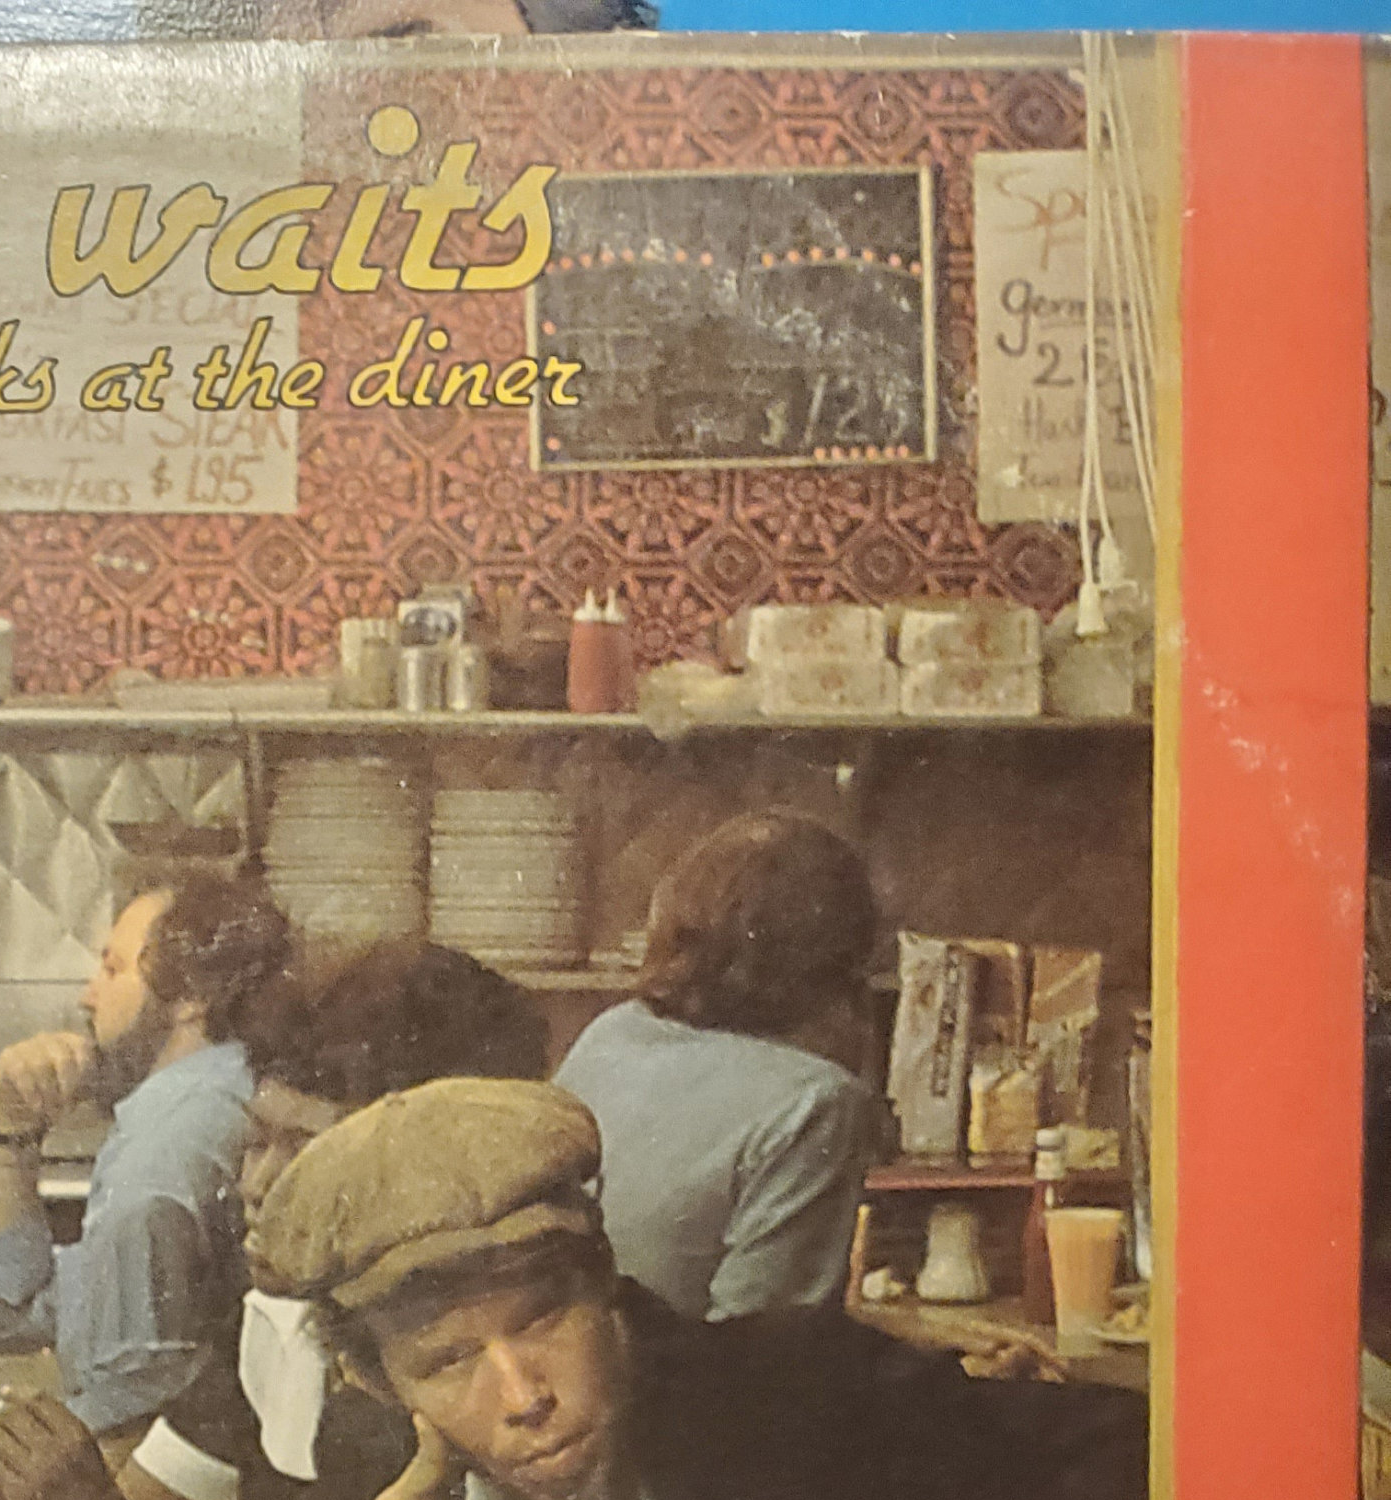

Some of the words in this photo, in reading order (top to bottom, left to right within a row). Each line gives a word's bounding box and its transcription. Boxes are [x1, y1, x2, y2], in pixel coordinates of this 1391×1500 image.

[46, 106, 560, 298] waits
[80, 344, 173, 412] at
[192, 315, 325, 412] the
[345, 314, 584, 408] diner
